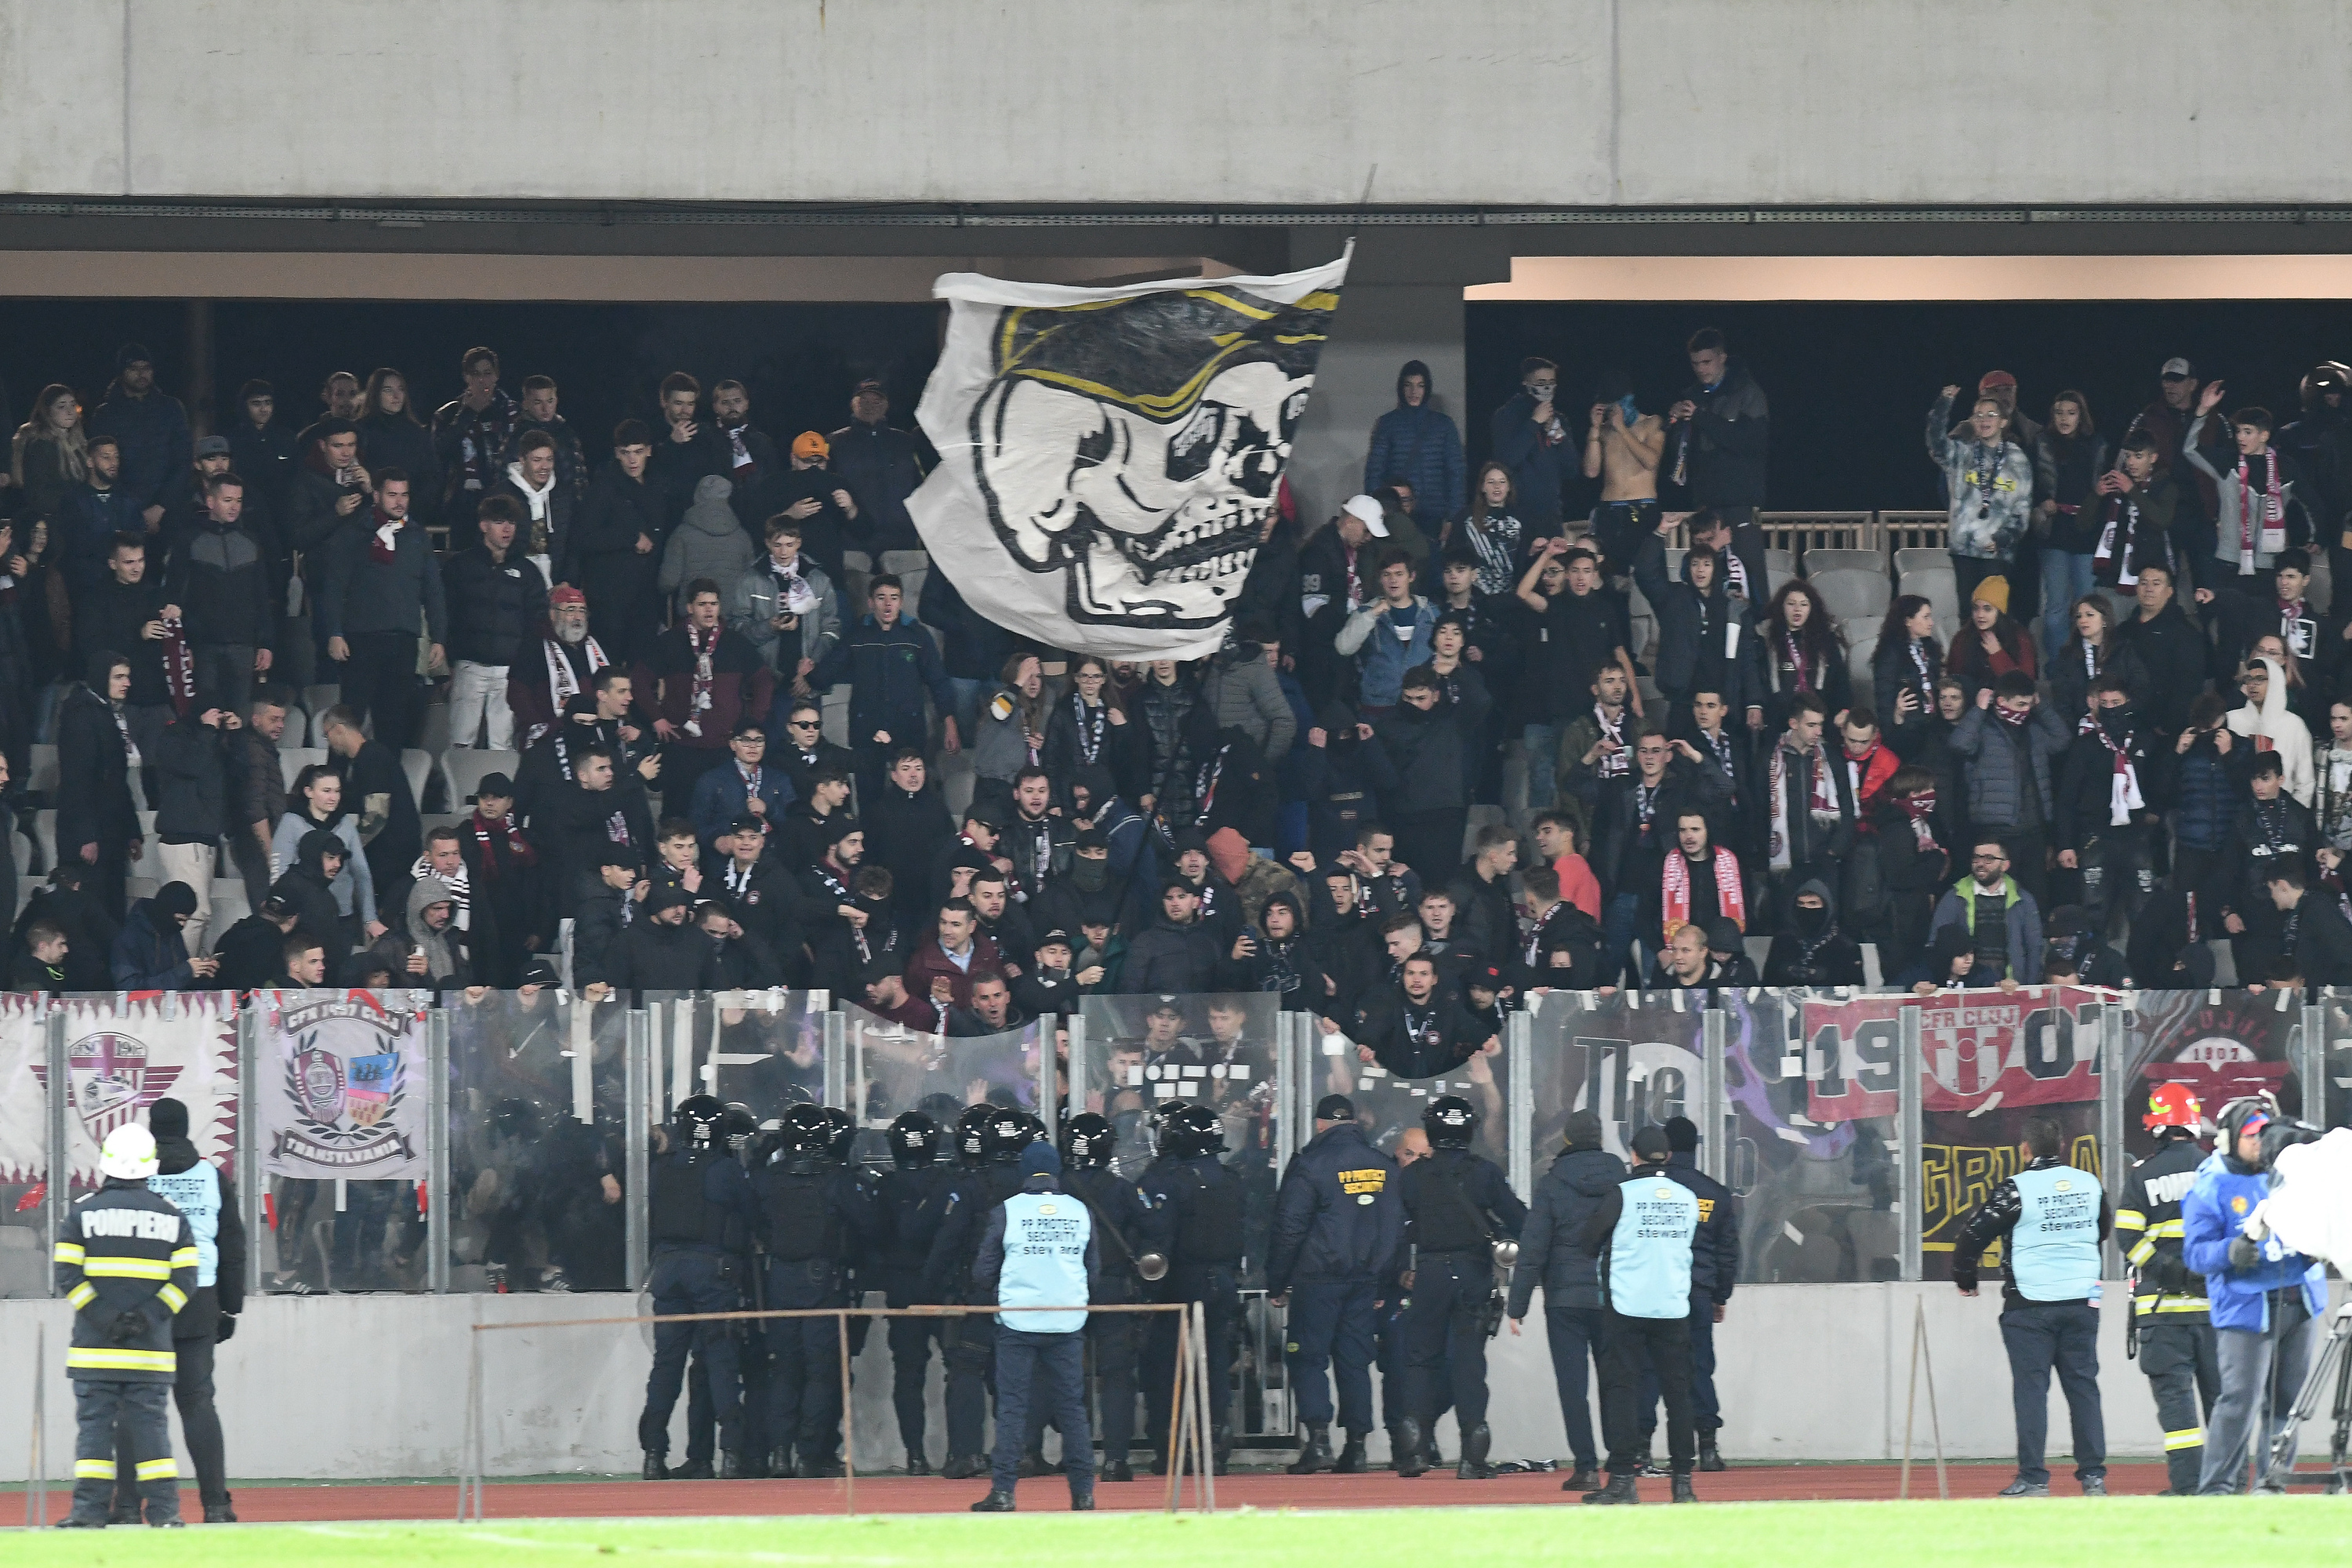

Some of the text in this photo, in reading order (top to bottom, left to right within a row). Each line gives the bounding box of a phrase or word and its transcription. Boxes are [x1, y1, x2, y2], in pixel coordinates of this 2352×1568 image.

[1964, 1008, 2013, 1025] CLUJ
[2052, 1192, 2092, 1206] PROTECT
[1650, 1201, 1690, 1214] PROTECT
[2044, 1205, 2090, 1220] SECURITY
[1036, 1218, 1080, 1231] PROTECT
[1641, 1214, 1687, 1225] SECURITY
[2040, 1216, 2092, 1232] steward
[1027, 1231, 1076, 1242] SECURITY
